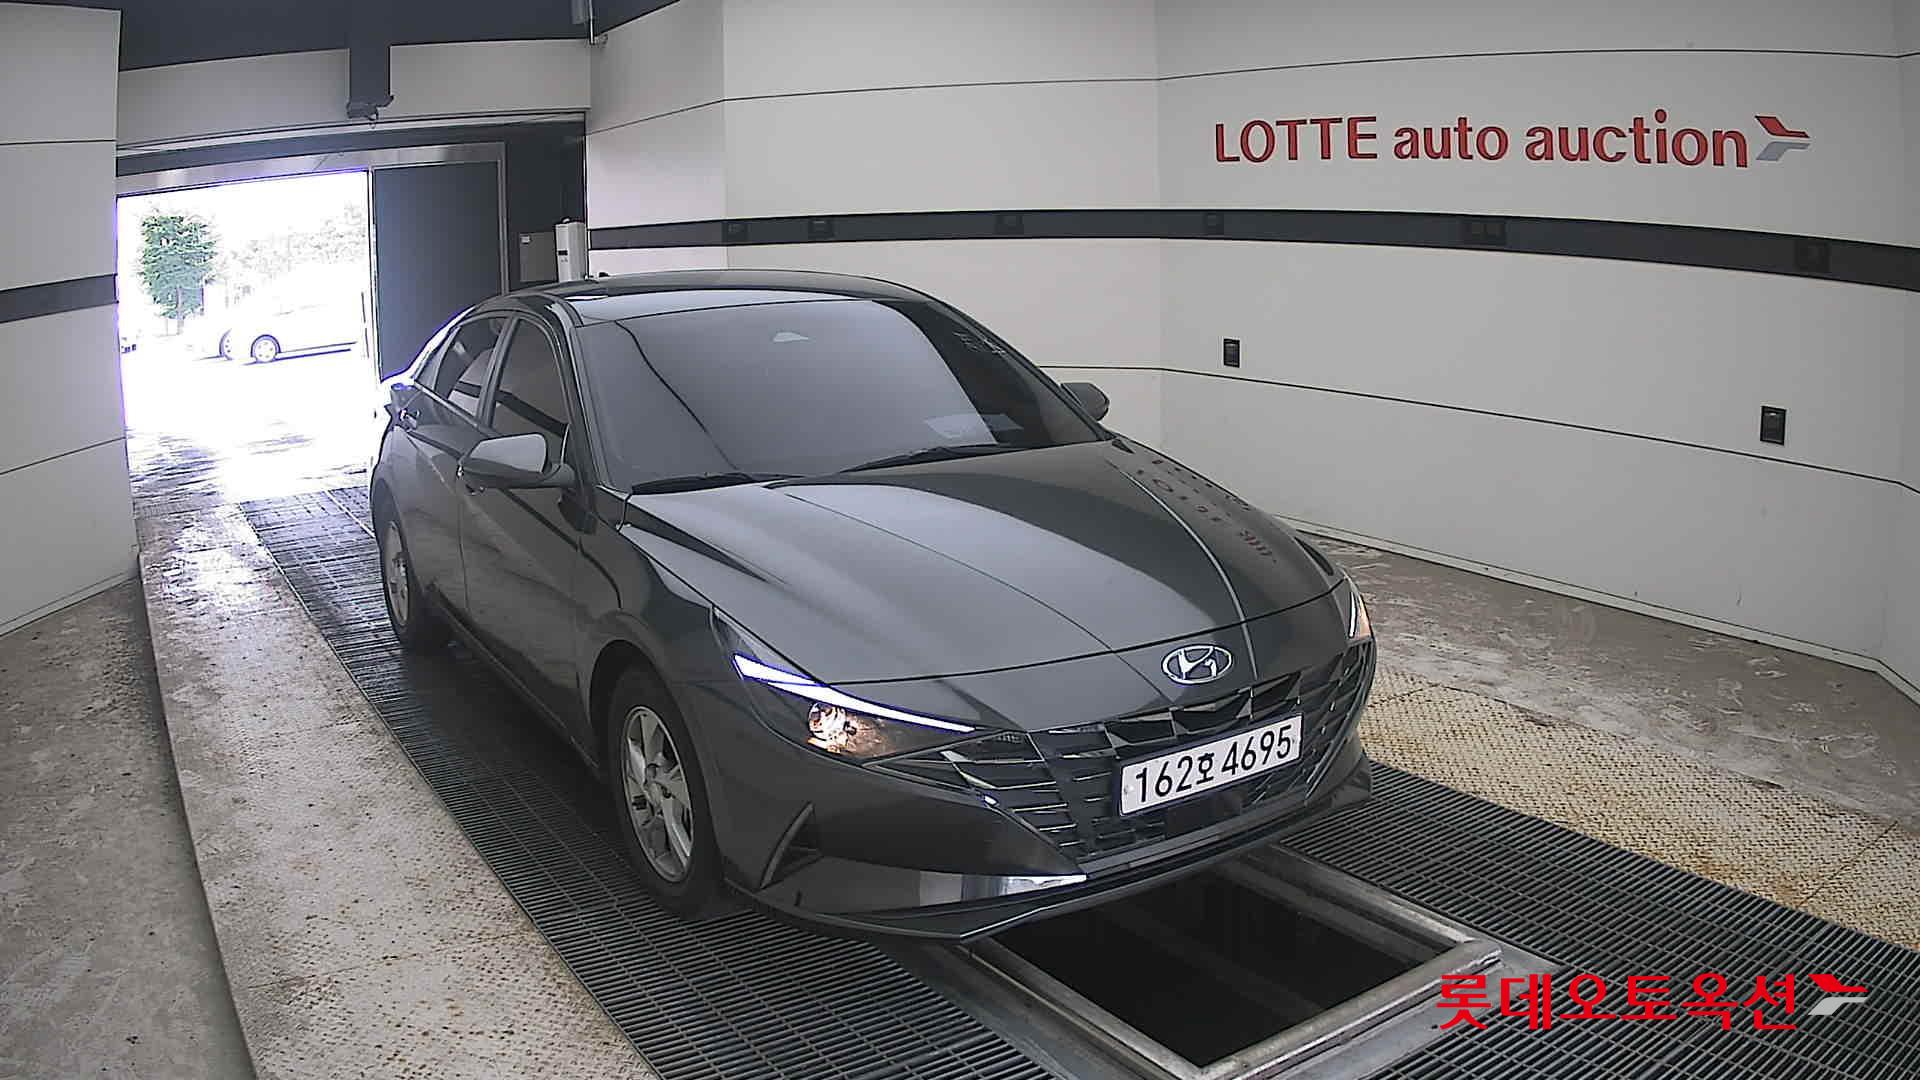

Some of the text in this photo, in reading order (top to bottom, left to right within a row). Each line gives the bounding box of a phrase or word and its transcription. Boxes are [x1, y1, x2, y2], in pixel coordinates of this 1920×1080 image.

[1215, 109, 1749, 168] LOTTE auto auction
[1135, 724, 1292, 803] 162호 4695
